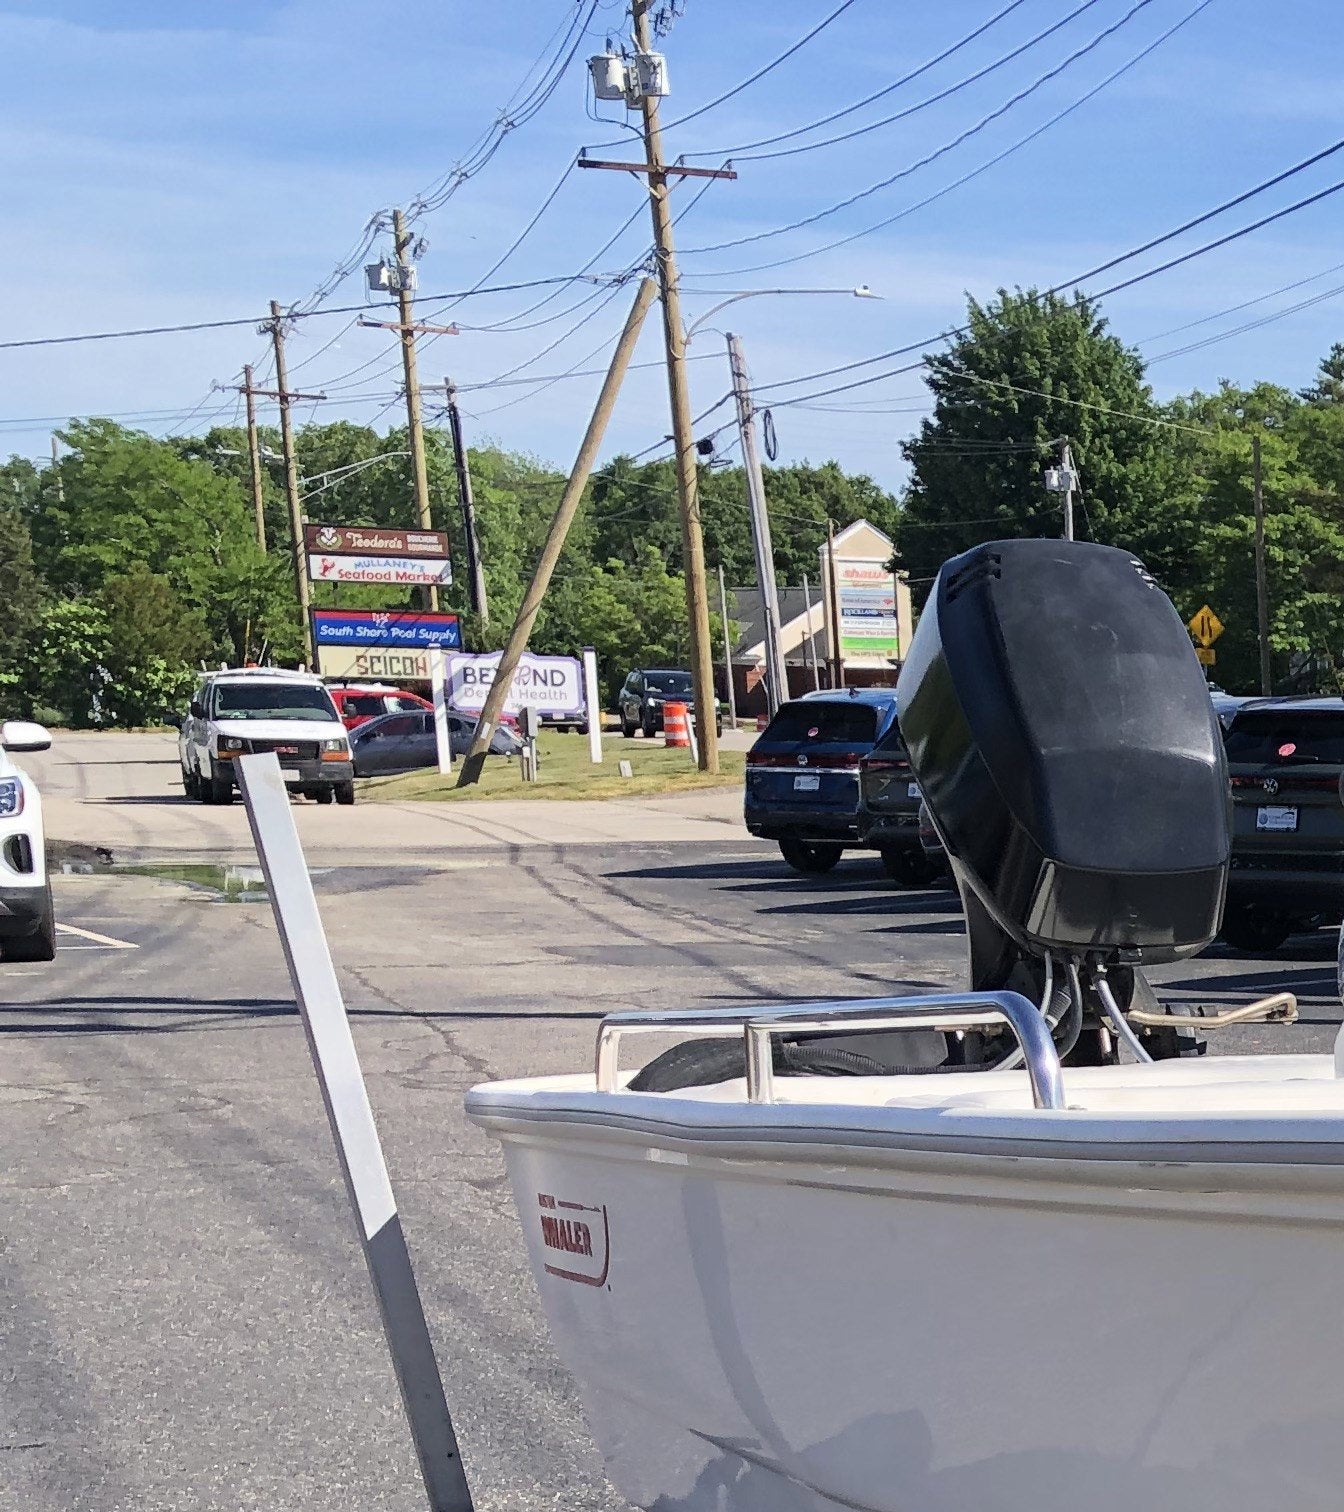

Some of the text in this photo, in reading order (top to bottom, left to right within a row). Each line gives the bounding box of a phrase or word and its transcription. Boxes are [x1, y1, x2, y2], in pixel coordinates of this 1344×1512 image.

[337, 568, 444, 583] Seafood Market
[319, 625, 456, 643] South Shore Pool Supply
[519, 689, 568, 700] Health
